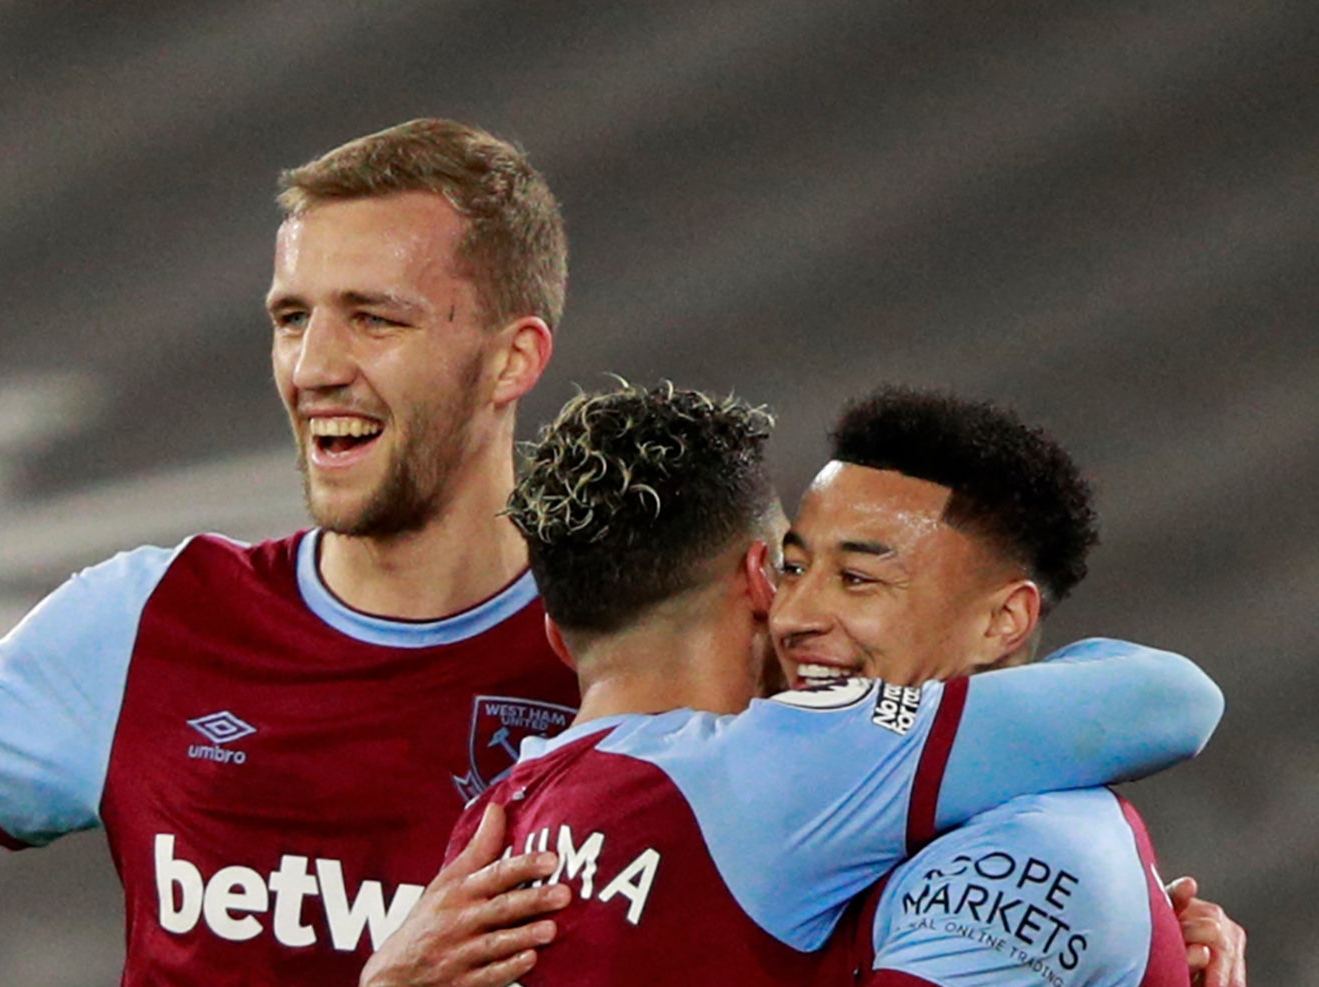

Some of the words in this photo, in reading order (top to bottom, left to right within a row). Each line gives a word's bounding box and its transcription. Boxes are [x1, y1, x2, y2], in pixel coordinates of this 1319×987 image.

[485, 703, 527, 717] WEST
[529, 707, 566, 727] HAM
[500, 714, 549, 731] UNITED
[188, 745, 247, 765] umbro
[902, 883, 1088, 971] MARKETS
[944, 922, 1007, 952] ONLINE
